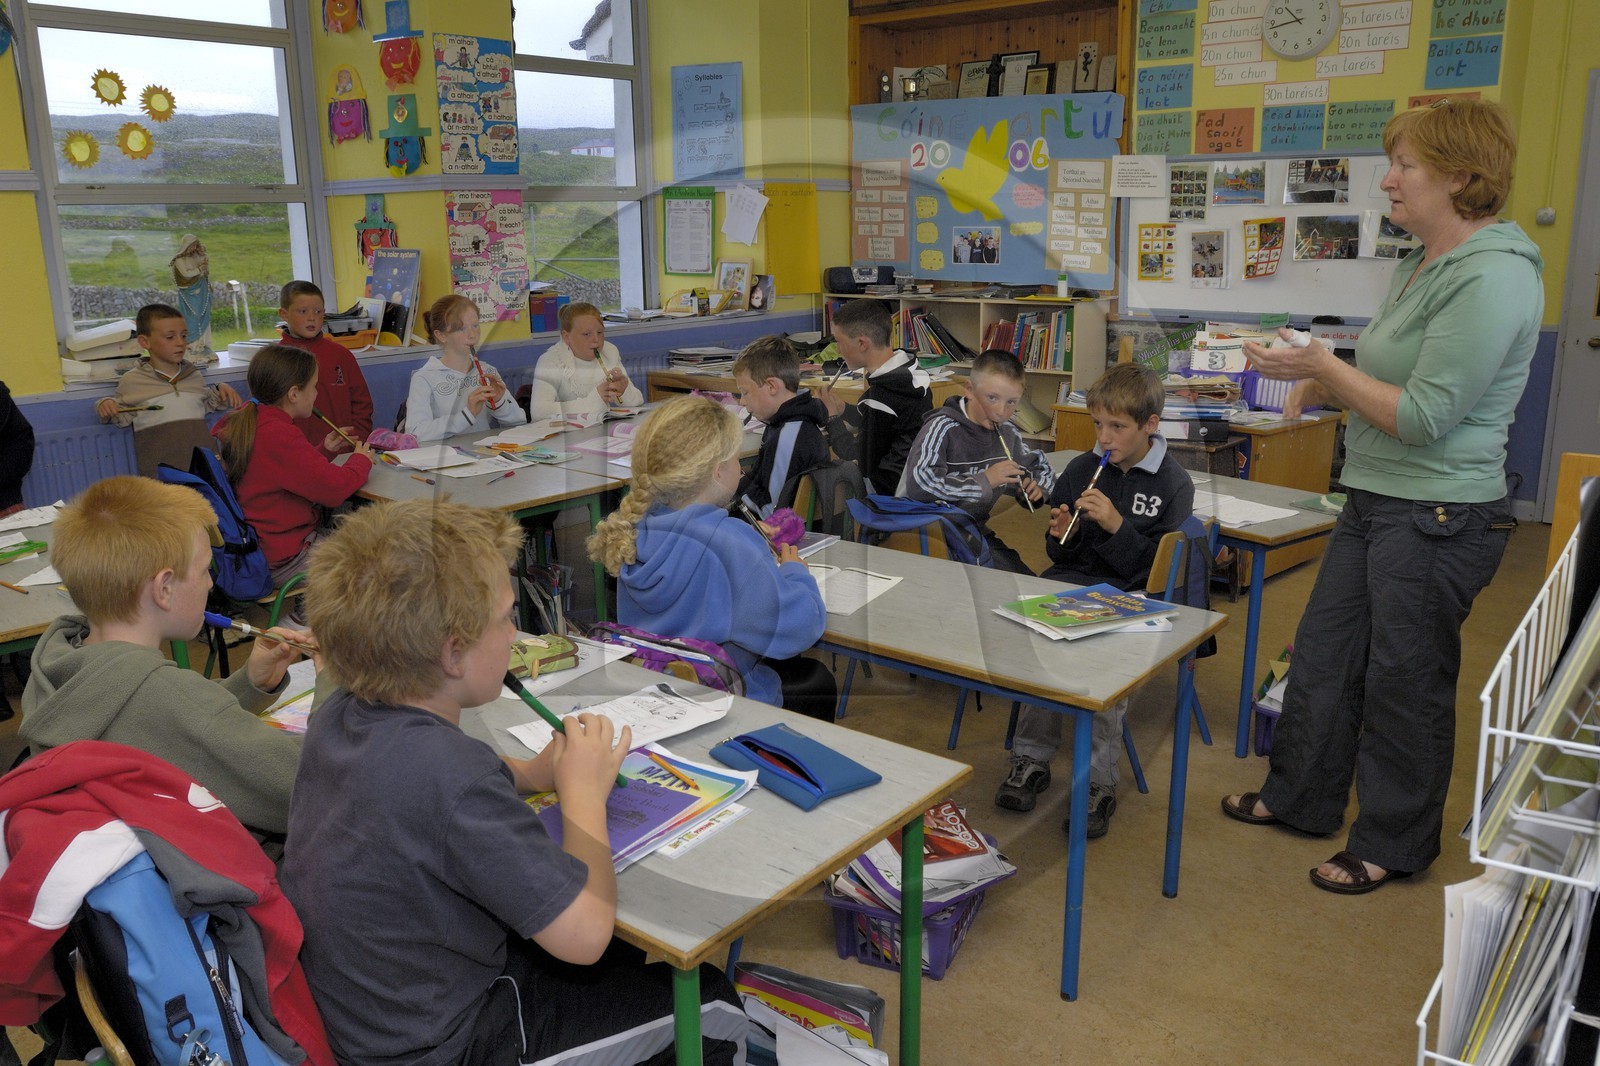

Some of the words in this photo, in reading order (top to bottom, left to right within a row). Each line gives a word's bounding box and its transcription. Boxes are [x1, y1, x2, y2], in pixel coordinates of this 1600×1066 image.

[1230, 4, 1256, 15] chun
[1274, 7, 1283, 15] 10
[1139, 18, 1195, 34] Beannacht
[1270, 19, 1275, 27] 9
[448, 37, 474, 46] m'athair
[1306, 37, 1312, 45] 5
[1226, 47, 1252, 60] chun
[1240, 66, 1267, 79] chun
[1435, 60, 1467, 77] ort
[694, 74, 723, 82] Syllables
[456, 90, 474, 99] athair
[1197, 112, 1225, 127] Fad
[911, 143, 950, 168] 20
[1008, 140, 1050, 169] 06
[377, 250, 387, 258] the
[400, 252, 417, 260] system
[1207, 352, 1227, 370] 3
[1131, 492, 1162, 517] 63
[940, 803, 980, 850] eason
